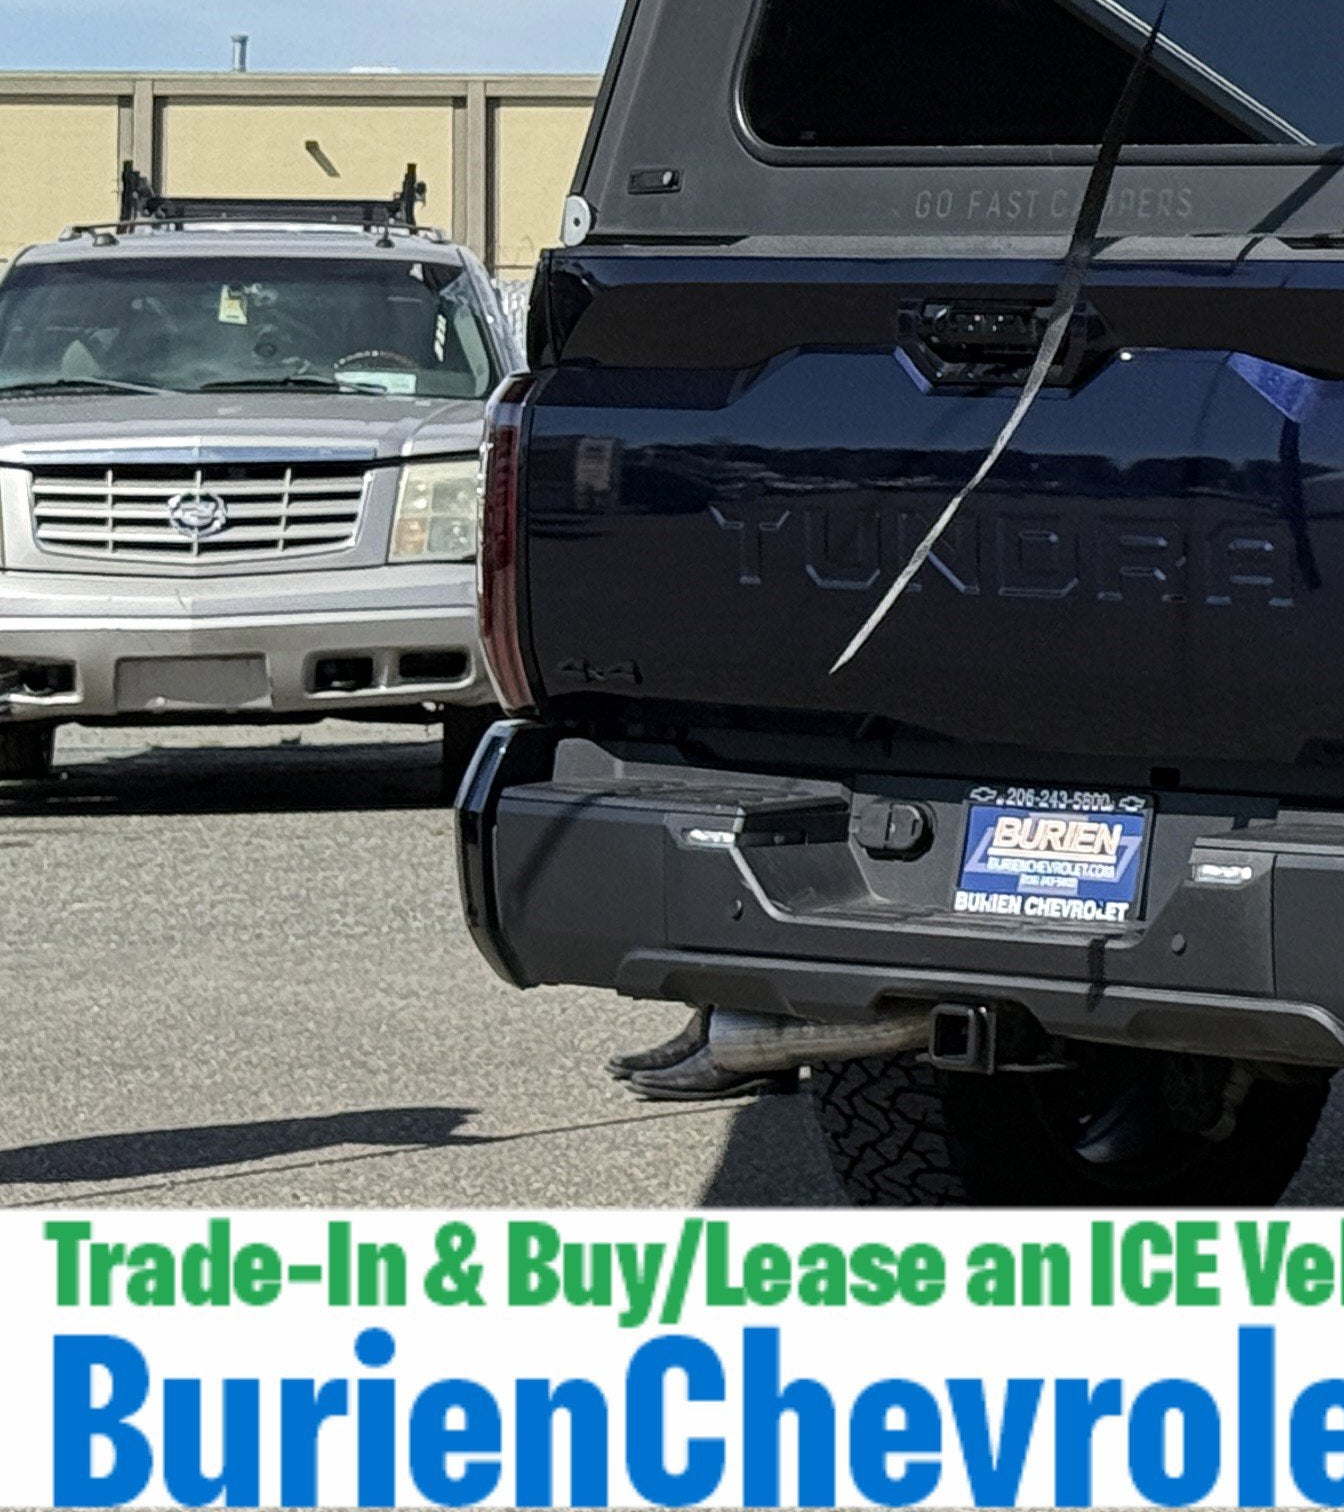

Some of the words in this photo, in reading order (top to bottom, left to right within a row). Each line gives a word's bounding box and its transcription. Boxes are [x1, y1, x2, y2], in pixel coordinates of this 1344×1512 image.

[914, 189, 953, 220] GO
[966, 188, 1040, 220] FAST
[709, 504, 1295, 608] TUNDRA
[992, 816, 1123, 855] BURIEN
[954, 890, 1022, 915] BURIEN
[1023, 895, 1129, 922] CHEVROLET
